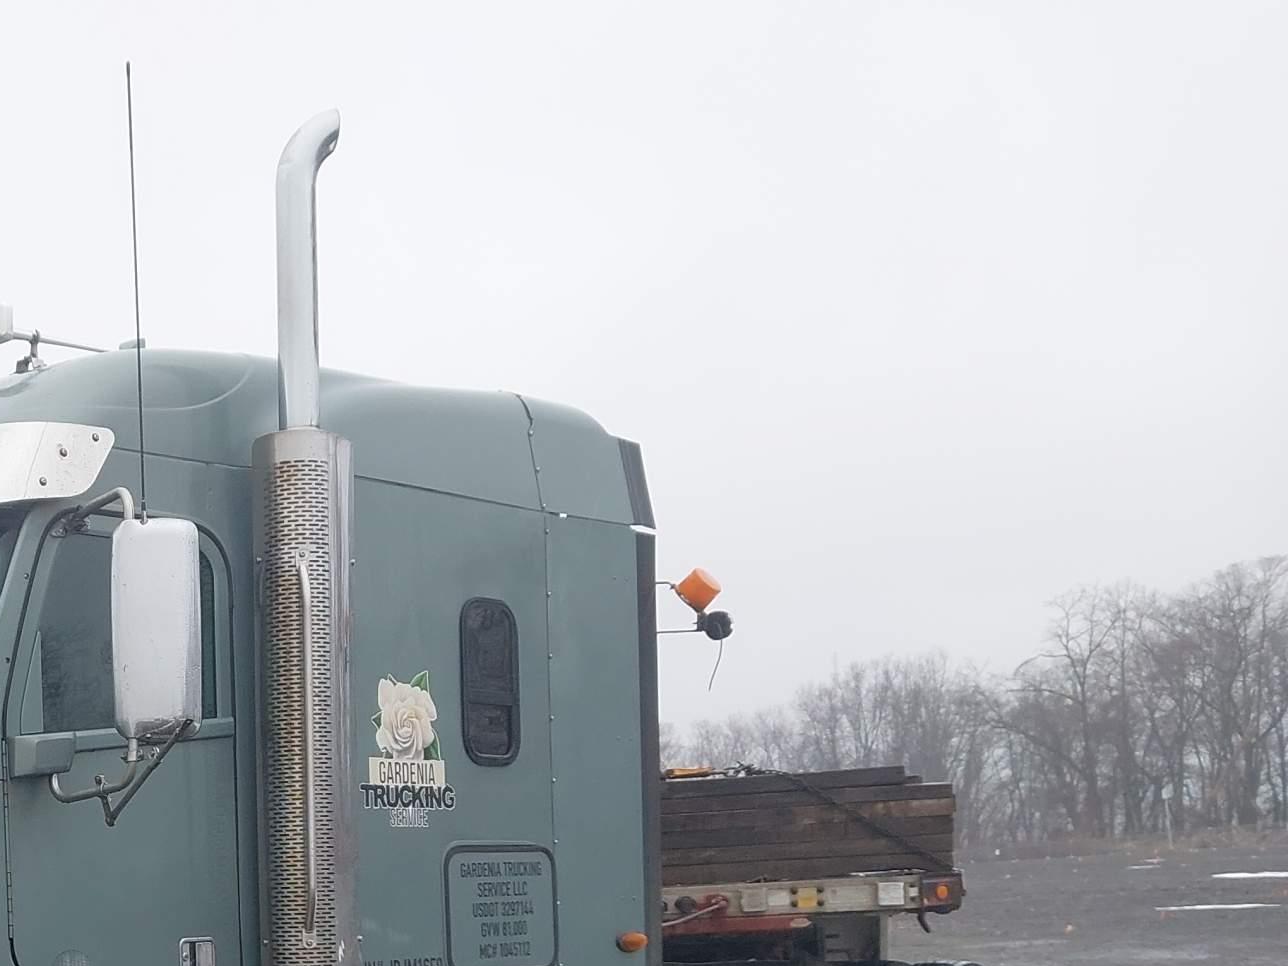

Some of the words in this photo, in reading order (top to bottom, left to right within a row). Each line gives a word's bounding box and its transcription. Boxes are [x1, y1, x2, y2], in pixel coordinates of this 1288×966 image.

[378, 761, 436, 785] GARDENIA
[360, 784, 456, 809] TRUCKING
[390, 808, 430, 827] SERVICE
[460, 862, 502, 878] GARDENIA
[503, 861, 542, 877] TRUCKING
[477, 881, 512, 897] SERVICE
[513, 880, 528, 896] LLC
[472, 902, 500, 918] USDOT
[480, 921, 500, 938] GVW
